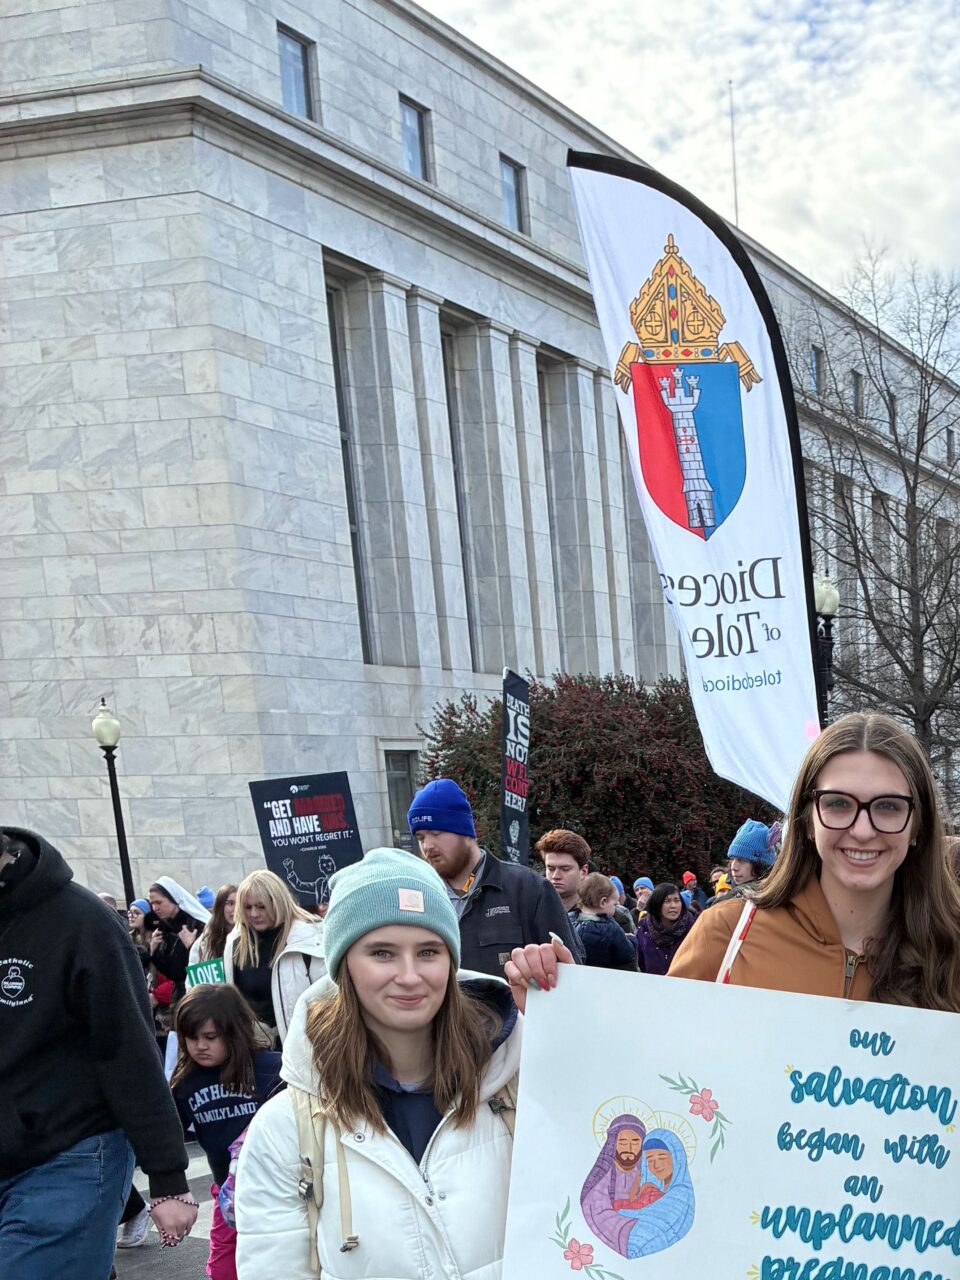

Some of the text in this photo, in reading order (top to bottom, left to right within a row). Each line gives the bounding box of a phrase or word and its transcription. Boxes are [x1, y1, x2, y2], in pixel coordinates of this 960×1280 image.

[507, 708, 530, 748] IS
[269, 818, 291, 837] AND
[292, 814, 321, 834] HAVE
[272, 837, 289, 848] YOU
[315, 831, 342, 842] REGRET
[850, 1029, 896, 1056] our
[790, 1066, 957, 1126] salvation
[194, 1101, 257, 1124] FAMILYLAND
[777, 1122, 950, 1169] began with
[844, 1175, 883, 1203] an
